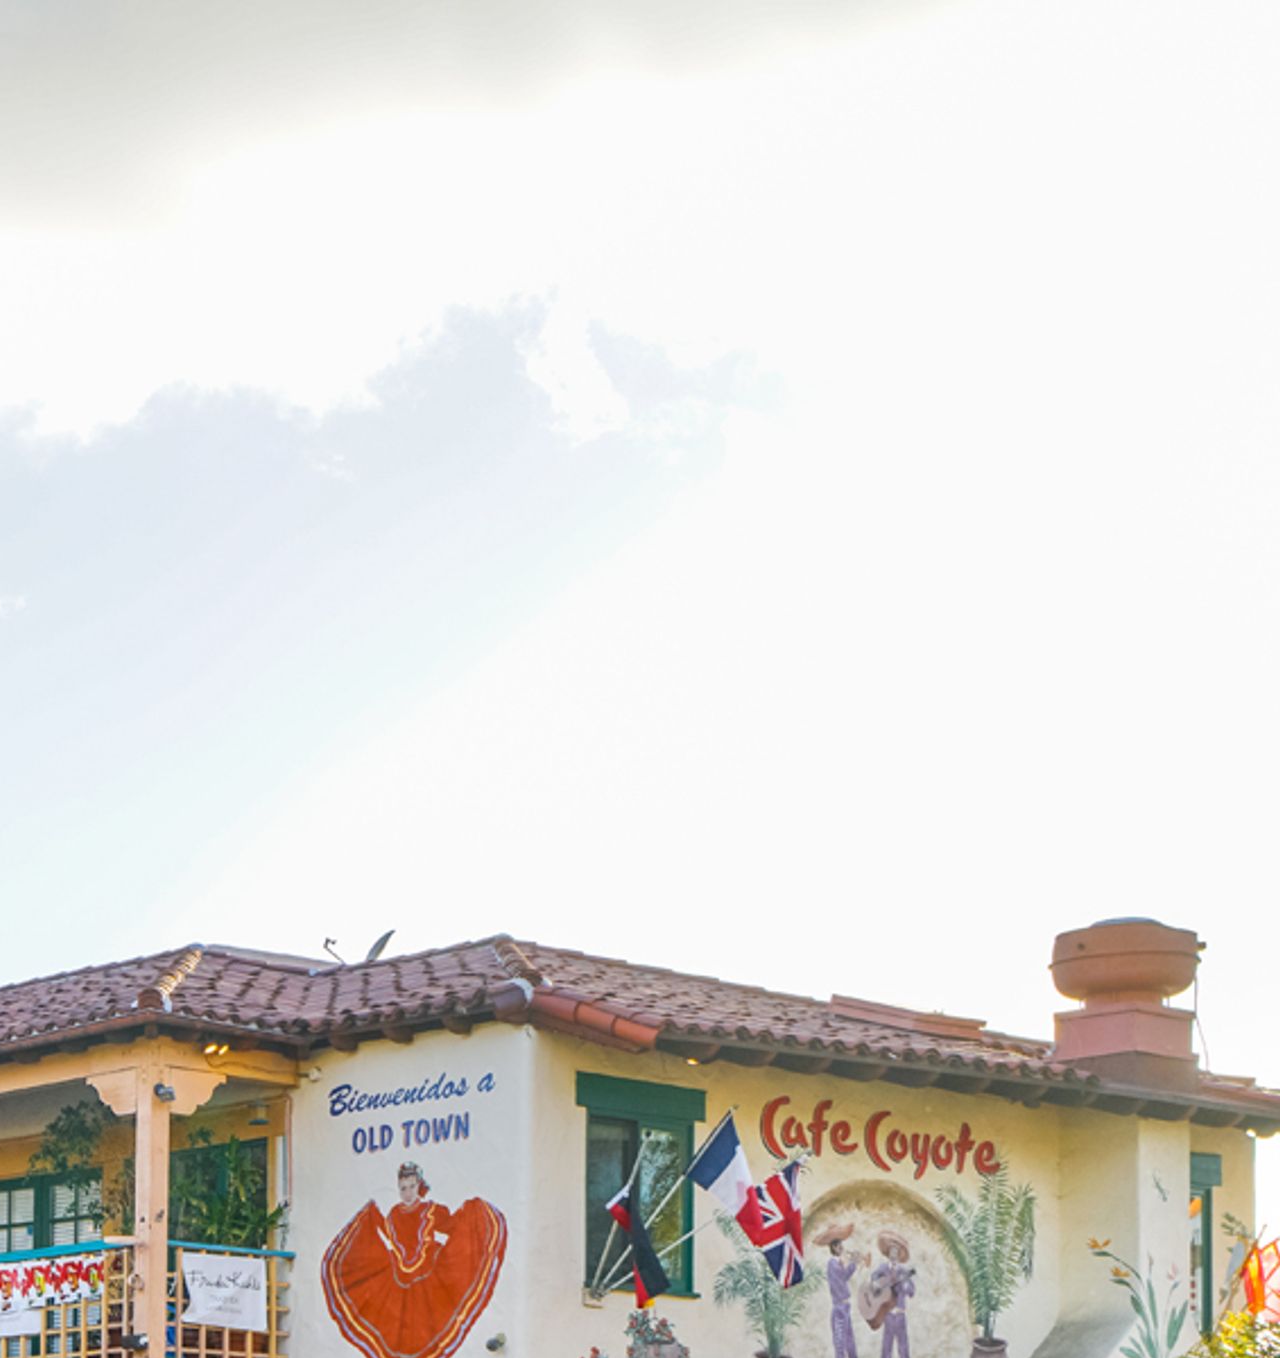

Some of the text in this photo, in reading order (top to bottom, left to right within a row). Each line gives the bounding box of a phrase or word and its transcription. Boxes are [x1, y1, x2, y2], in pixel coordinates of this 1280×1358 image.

[328, 1071, 497, 1117] Bienvenidos a
[352, 1111, 471, 1154] OLD TOWN
[760, 1095, 1001, 1180] Cafe Coyote
